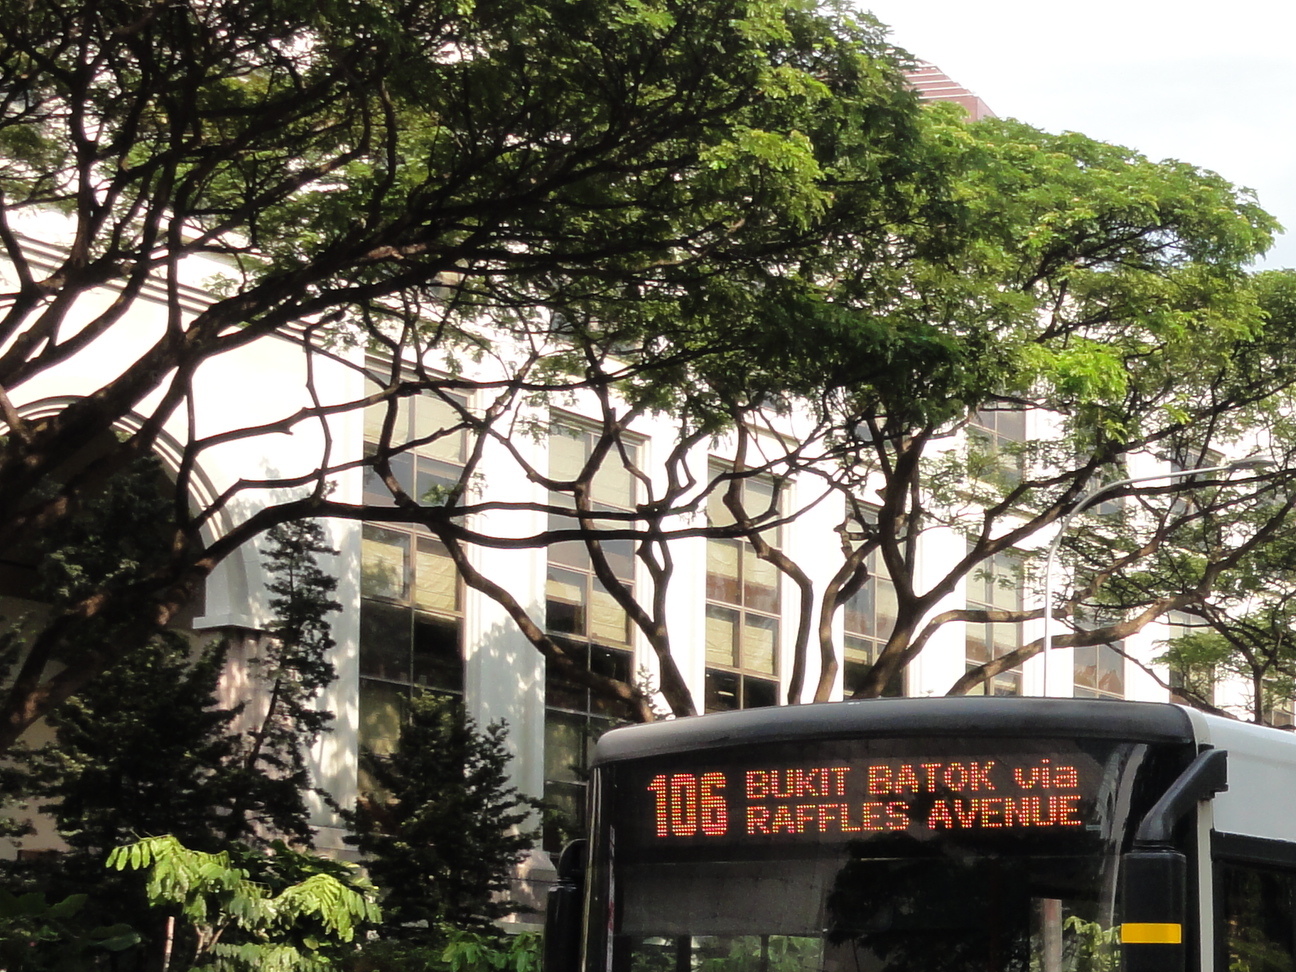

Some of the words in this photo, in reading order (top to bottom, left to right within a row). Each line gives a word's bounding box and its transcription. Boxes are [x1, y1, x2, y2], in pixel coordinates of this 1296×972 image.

[745, 766, 850, 799] BUKIT
[867, 760, 996, 796] BATOK
[1014, 758, 1078, 790] via
[646, 771, 727, 838] 106
[746, 800, 910, 835] RAFFLES
[927, 794, 1082, 830] AVENUE
